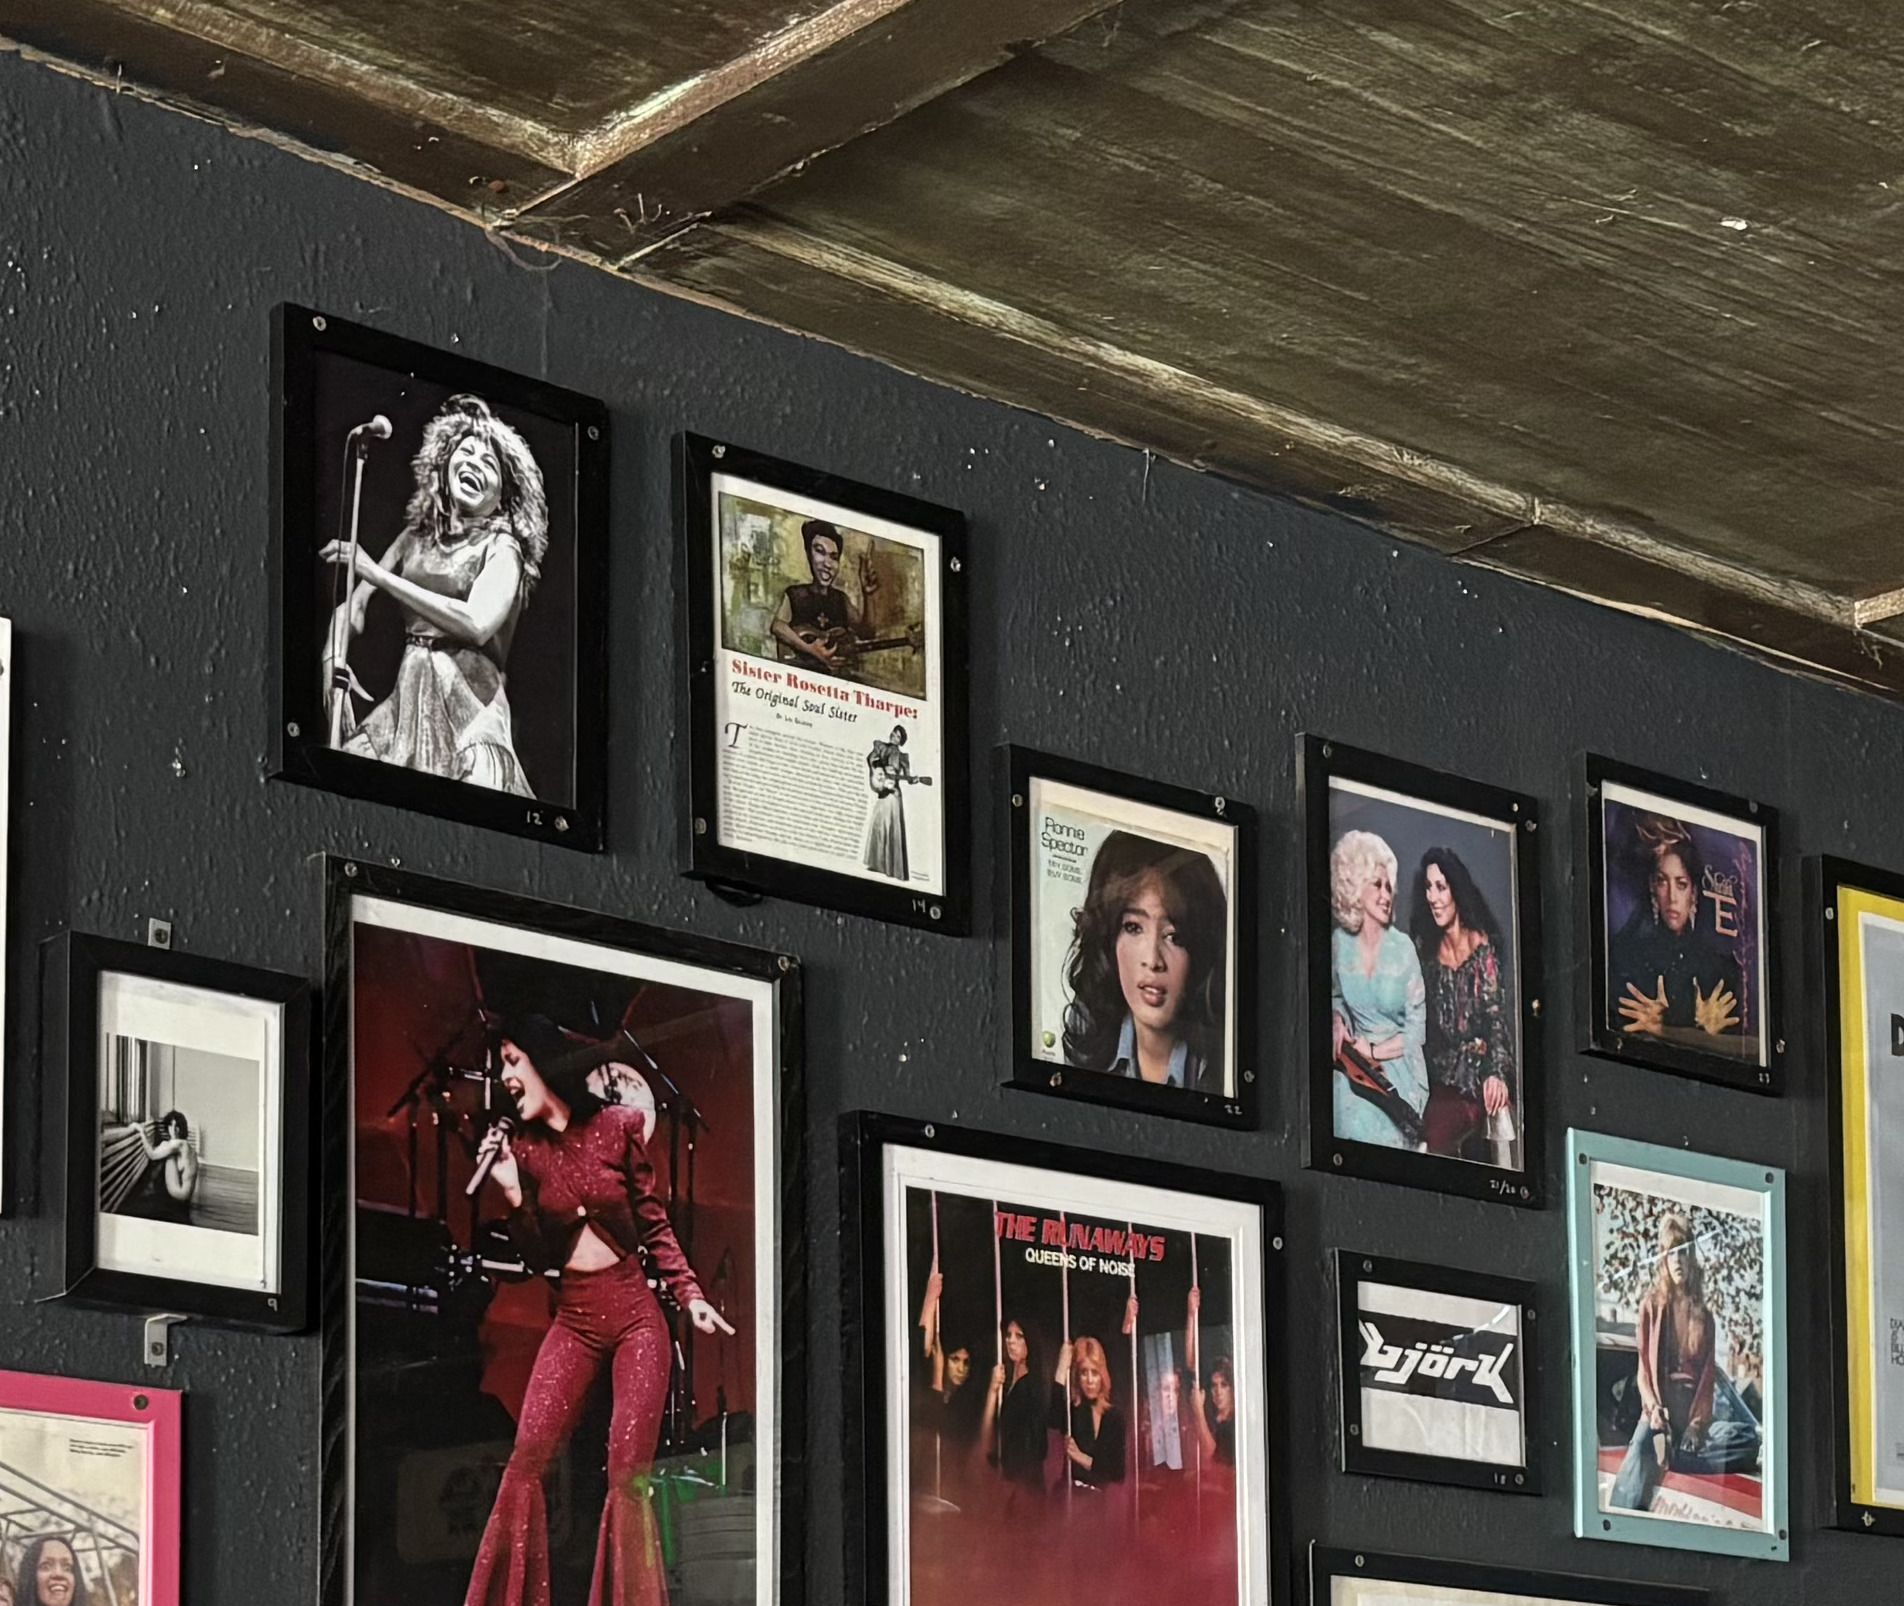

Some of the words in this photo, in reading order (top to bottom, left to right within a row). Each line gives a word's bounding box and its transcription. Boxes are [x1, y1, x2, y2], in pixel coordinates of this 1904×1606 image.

[732, 659, 782, 685] Sister
[786, 673, 850, 702] Rosetta
[853, 690, 918, 719] Tharpe:
[732, 681, 751, 696] The
[755, 688, 799, 707] Original
[804, 699, 825, 715] Soul
[828, 706, 858, 723] Sister
[527, 811, 543, 825] 12
[1041, 832, 1088, 856] Spector
[912, 899, 926, 914] 14
[1703, 890, 1738, 936] E
[996, 1211, 1036, 1241] THE
[1042, 1218, 1165, 1261] RUNAWAYS
[1025, 1248, 1076, 1269] QUEENS
[1079, 1254, 1096, 1272] OF
[1099, 1257, 1135, 1278] NOISE
[1359, 1319, 1514, 1404] björk
